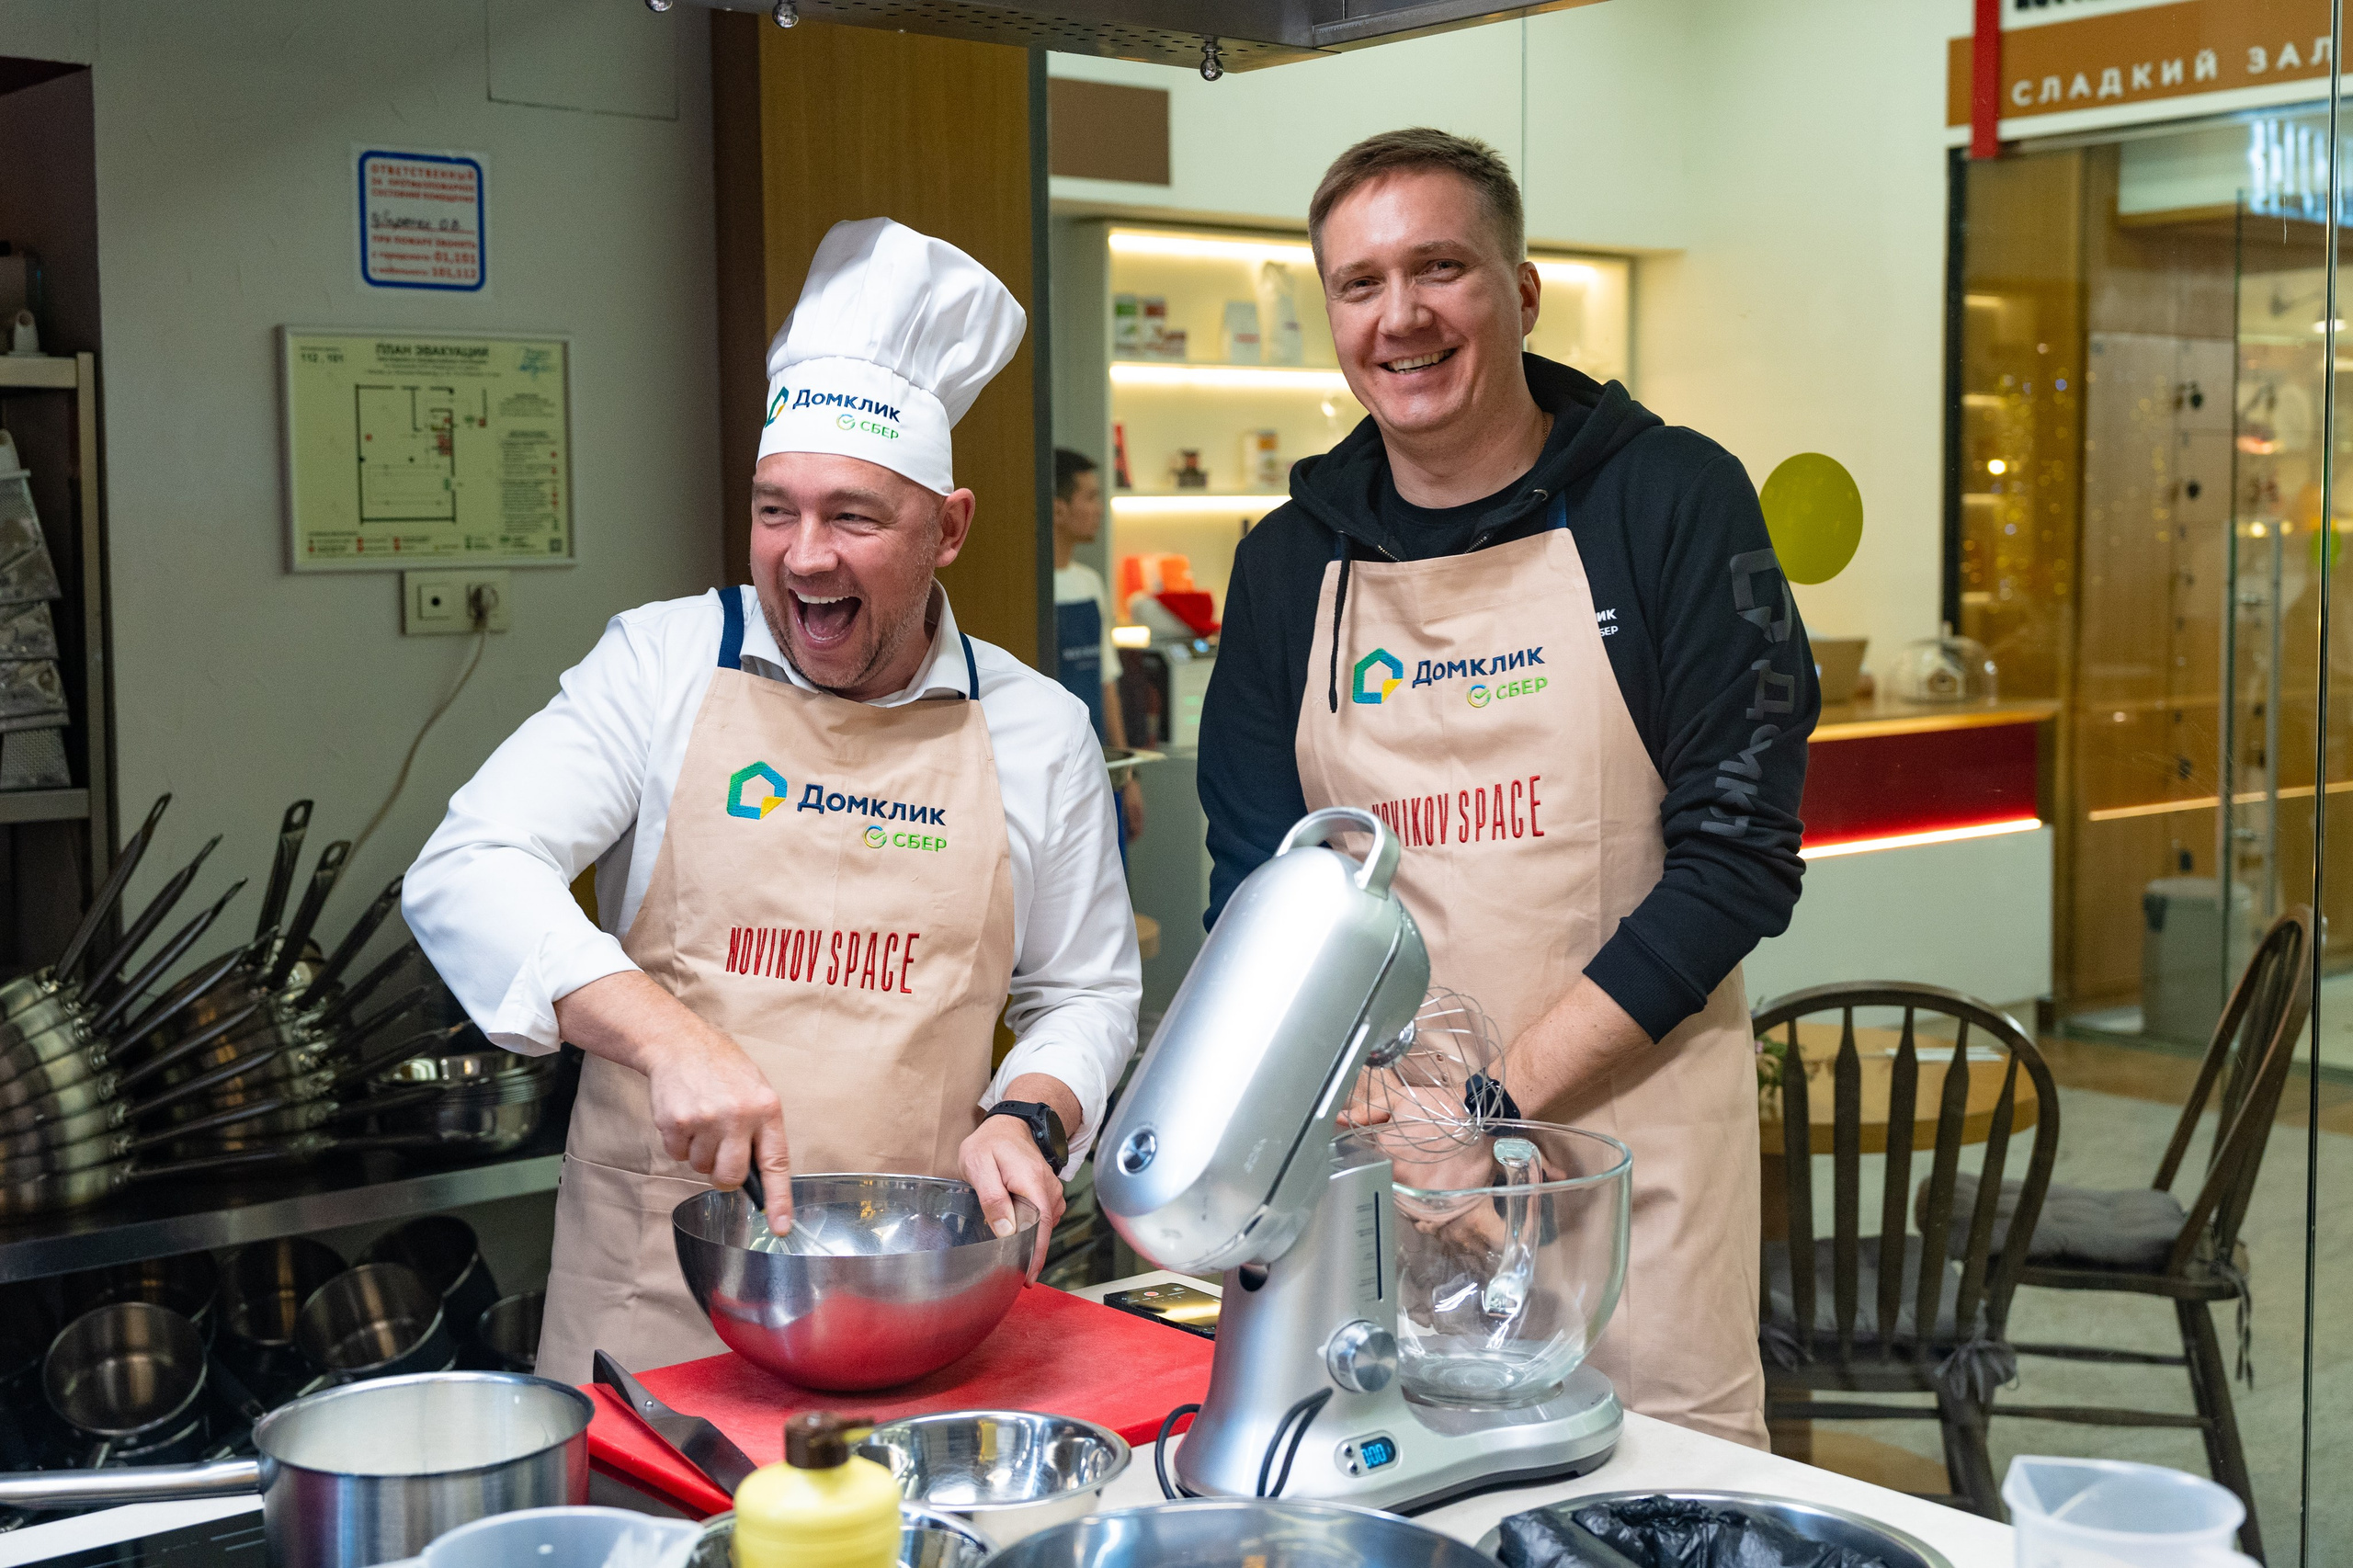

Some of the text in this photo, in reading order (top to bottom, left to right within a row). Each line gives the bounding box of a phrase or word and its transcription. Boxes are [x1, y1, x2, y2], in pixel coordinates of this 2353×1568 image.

[2011, 36, 2331, 106] СЛАДКИЙ ЗАЛ
[375, 343, 412, 355] ПЛАН
[859, 420, 899, 439] СБЕР
[1496, 676, 1548, 699] СБЕР
[1371, 775, 1544, 846] OVIKOV SPACE
[892, 832, 947, 852] СБЕР
[725, 927, 920, 994] NOVIKOV SPACE
